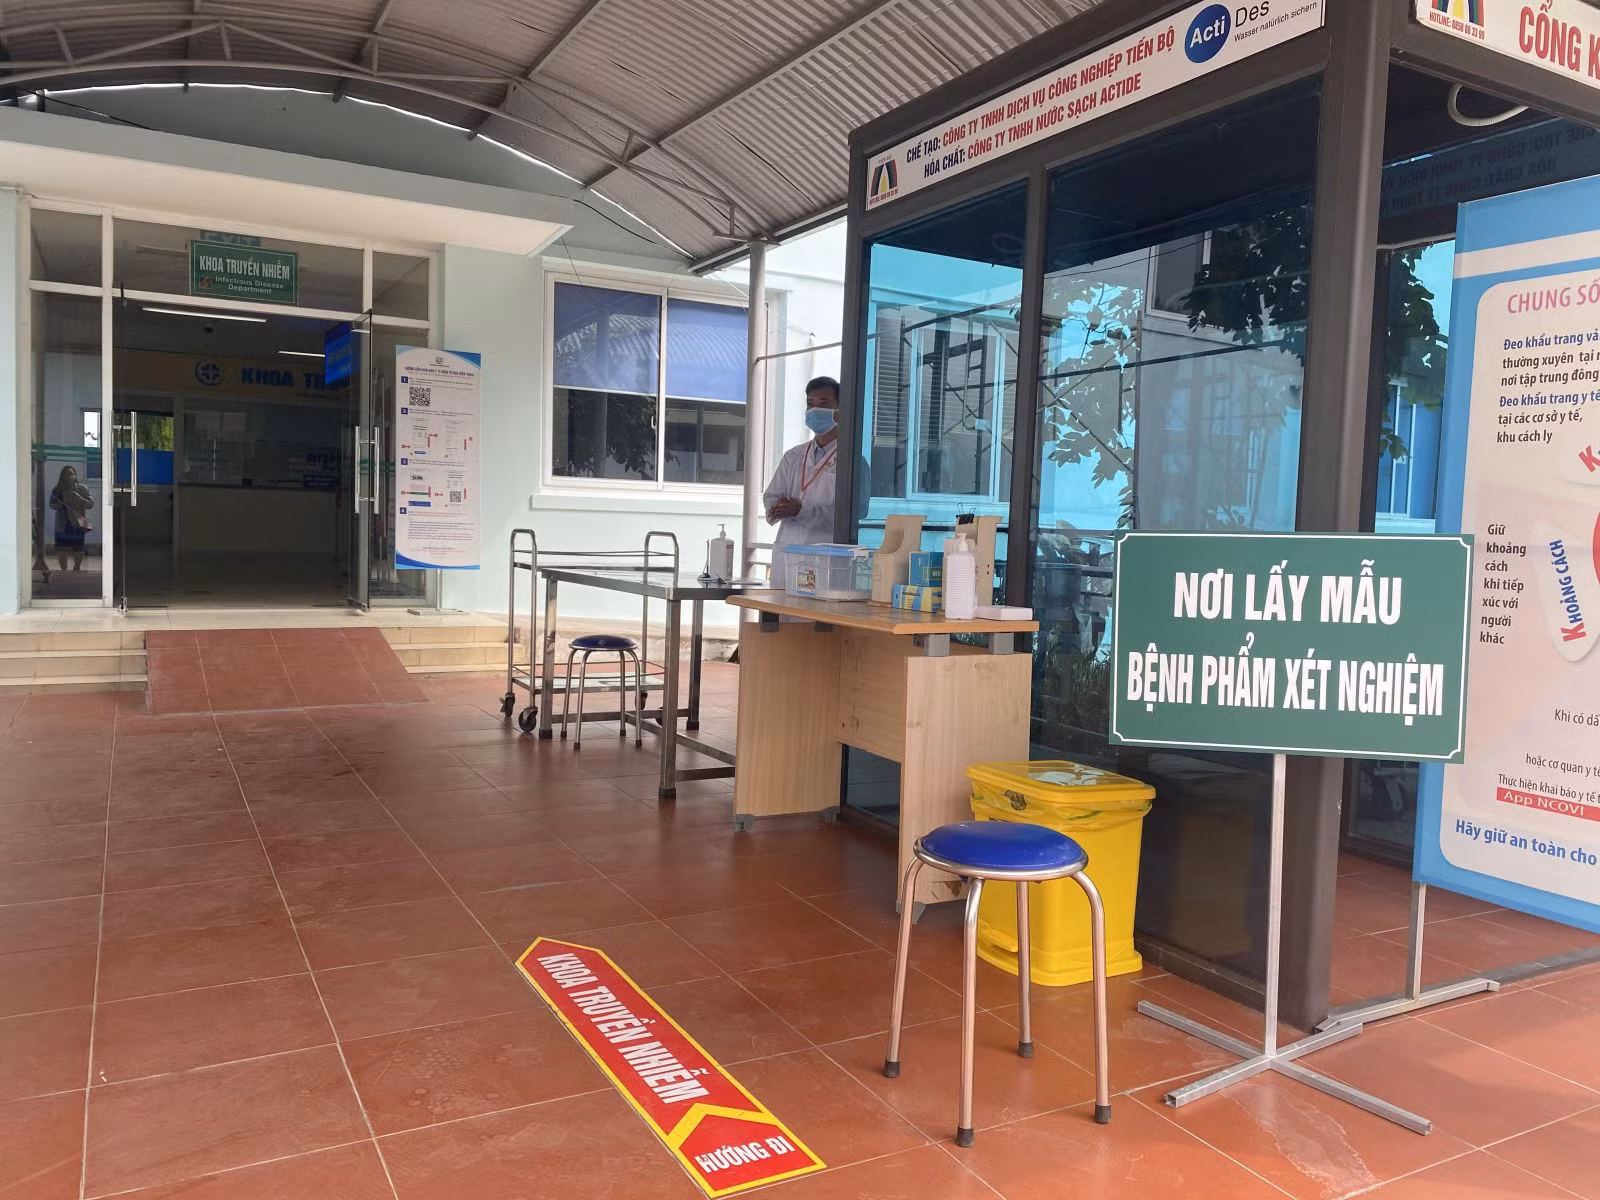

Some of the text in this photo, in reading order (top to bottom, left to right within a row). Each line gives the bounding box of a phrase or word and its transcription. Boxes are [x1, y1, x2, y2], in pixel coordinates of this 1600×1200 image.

[1234, 2, 1317, 42] Wasser natürlich sichern
[1236, 1, 1269, 27] Des
[1190, 16, 1225, 48] Acti
[1519, 0, 1582, 72] CỔNG
[907, 26, 1175, 163] CHẾ TẠO: CÔNG TY TNHH DỊCH VỤ CÔNG NGHIỆP TIẾN BỘ
[924, 72, 1142, 178] HÓA CHẤT: CÔNG TY TNHH NƯỚC SẠCH ACTIDE
[200, 256, 224, 273] KHOA
[226, 256, 260, 276] TRUYỀN
[216, 276, 253, 286] Infectious
[228, 284, 272, 295] Department
[1508, 286, 1572, 314] CHUNG
[1504, 328, 1600, 350] Đeo khẩu trang vả
[1503, 355, 1540, 370] thường
[1542, 352, 1574, 368] xuyên
[1579, 349, 1594, 365] tại
[242, 368, 294, 387] KHOA
[1501, 368, 1600, 388] nơi tập trung đông
[1500, 396, 1519, 408] Đeo
[1521, 392, 1547, 406] khẩu
[1550, 393, 1579, 406] trang
[1582, 392, 1588, 406] y
[1498, 408, 1583, 428] tại các cơ sở y tế,
[1497, 430, 1553, 444] khu cách ly
[1488, 524, 1506, 536] Giữ
[1486, 542, 1527, 557] khoảng
[1549, 540, 1569, 574] CÁCH
[1485, 560, 1508, 572] cách
[1174, 559, 1402, 626] NƠI LẤY MẪU
[1484, 578, 1524, 594] khi tiếp
[1482, 596, 1519, 609] xúc với
[1481, 616, 1512, 628] người
[1480, 632, 1505, 644] khác
[1126, 632, 1444, 726] BỆNH PHẨM XÉT NGHIỆM
[1554, 708, 1571, 722] Khi
[1573, 712, 1584, 724] có
[1526, 753, 1546, 769] hoặc
[1548, 760, 1560, 770] cơ
[1560, 762, 1584, 774] quan
[1585, 766, 1591, 778] y
[1498, 774, 1518, 788] Thực
[1520, 778, 1538, 792] hiện
[1540, 782, 1558, 796] khai
[1560, 786, 1576, 800] báo
[1578, 791, 1584, 802] y
[1586, 791, 1596, 803] tế
[1504, 791, 1533, 807] App
[1538, 798, 1584, 817] NCOVI
[1456, 819, 1598, 866] Hãy giữ an toàn cho
[537, 952, 710, 1104] KHOA TRUYỀN NHIỄM
[694, 1135, 796, 1174] HƯỚNG ĐI
